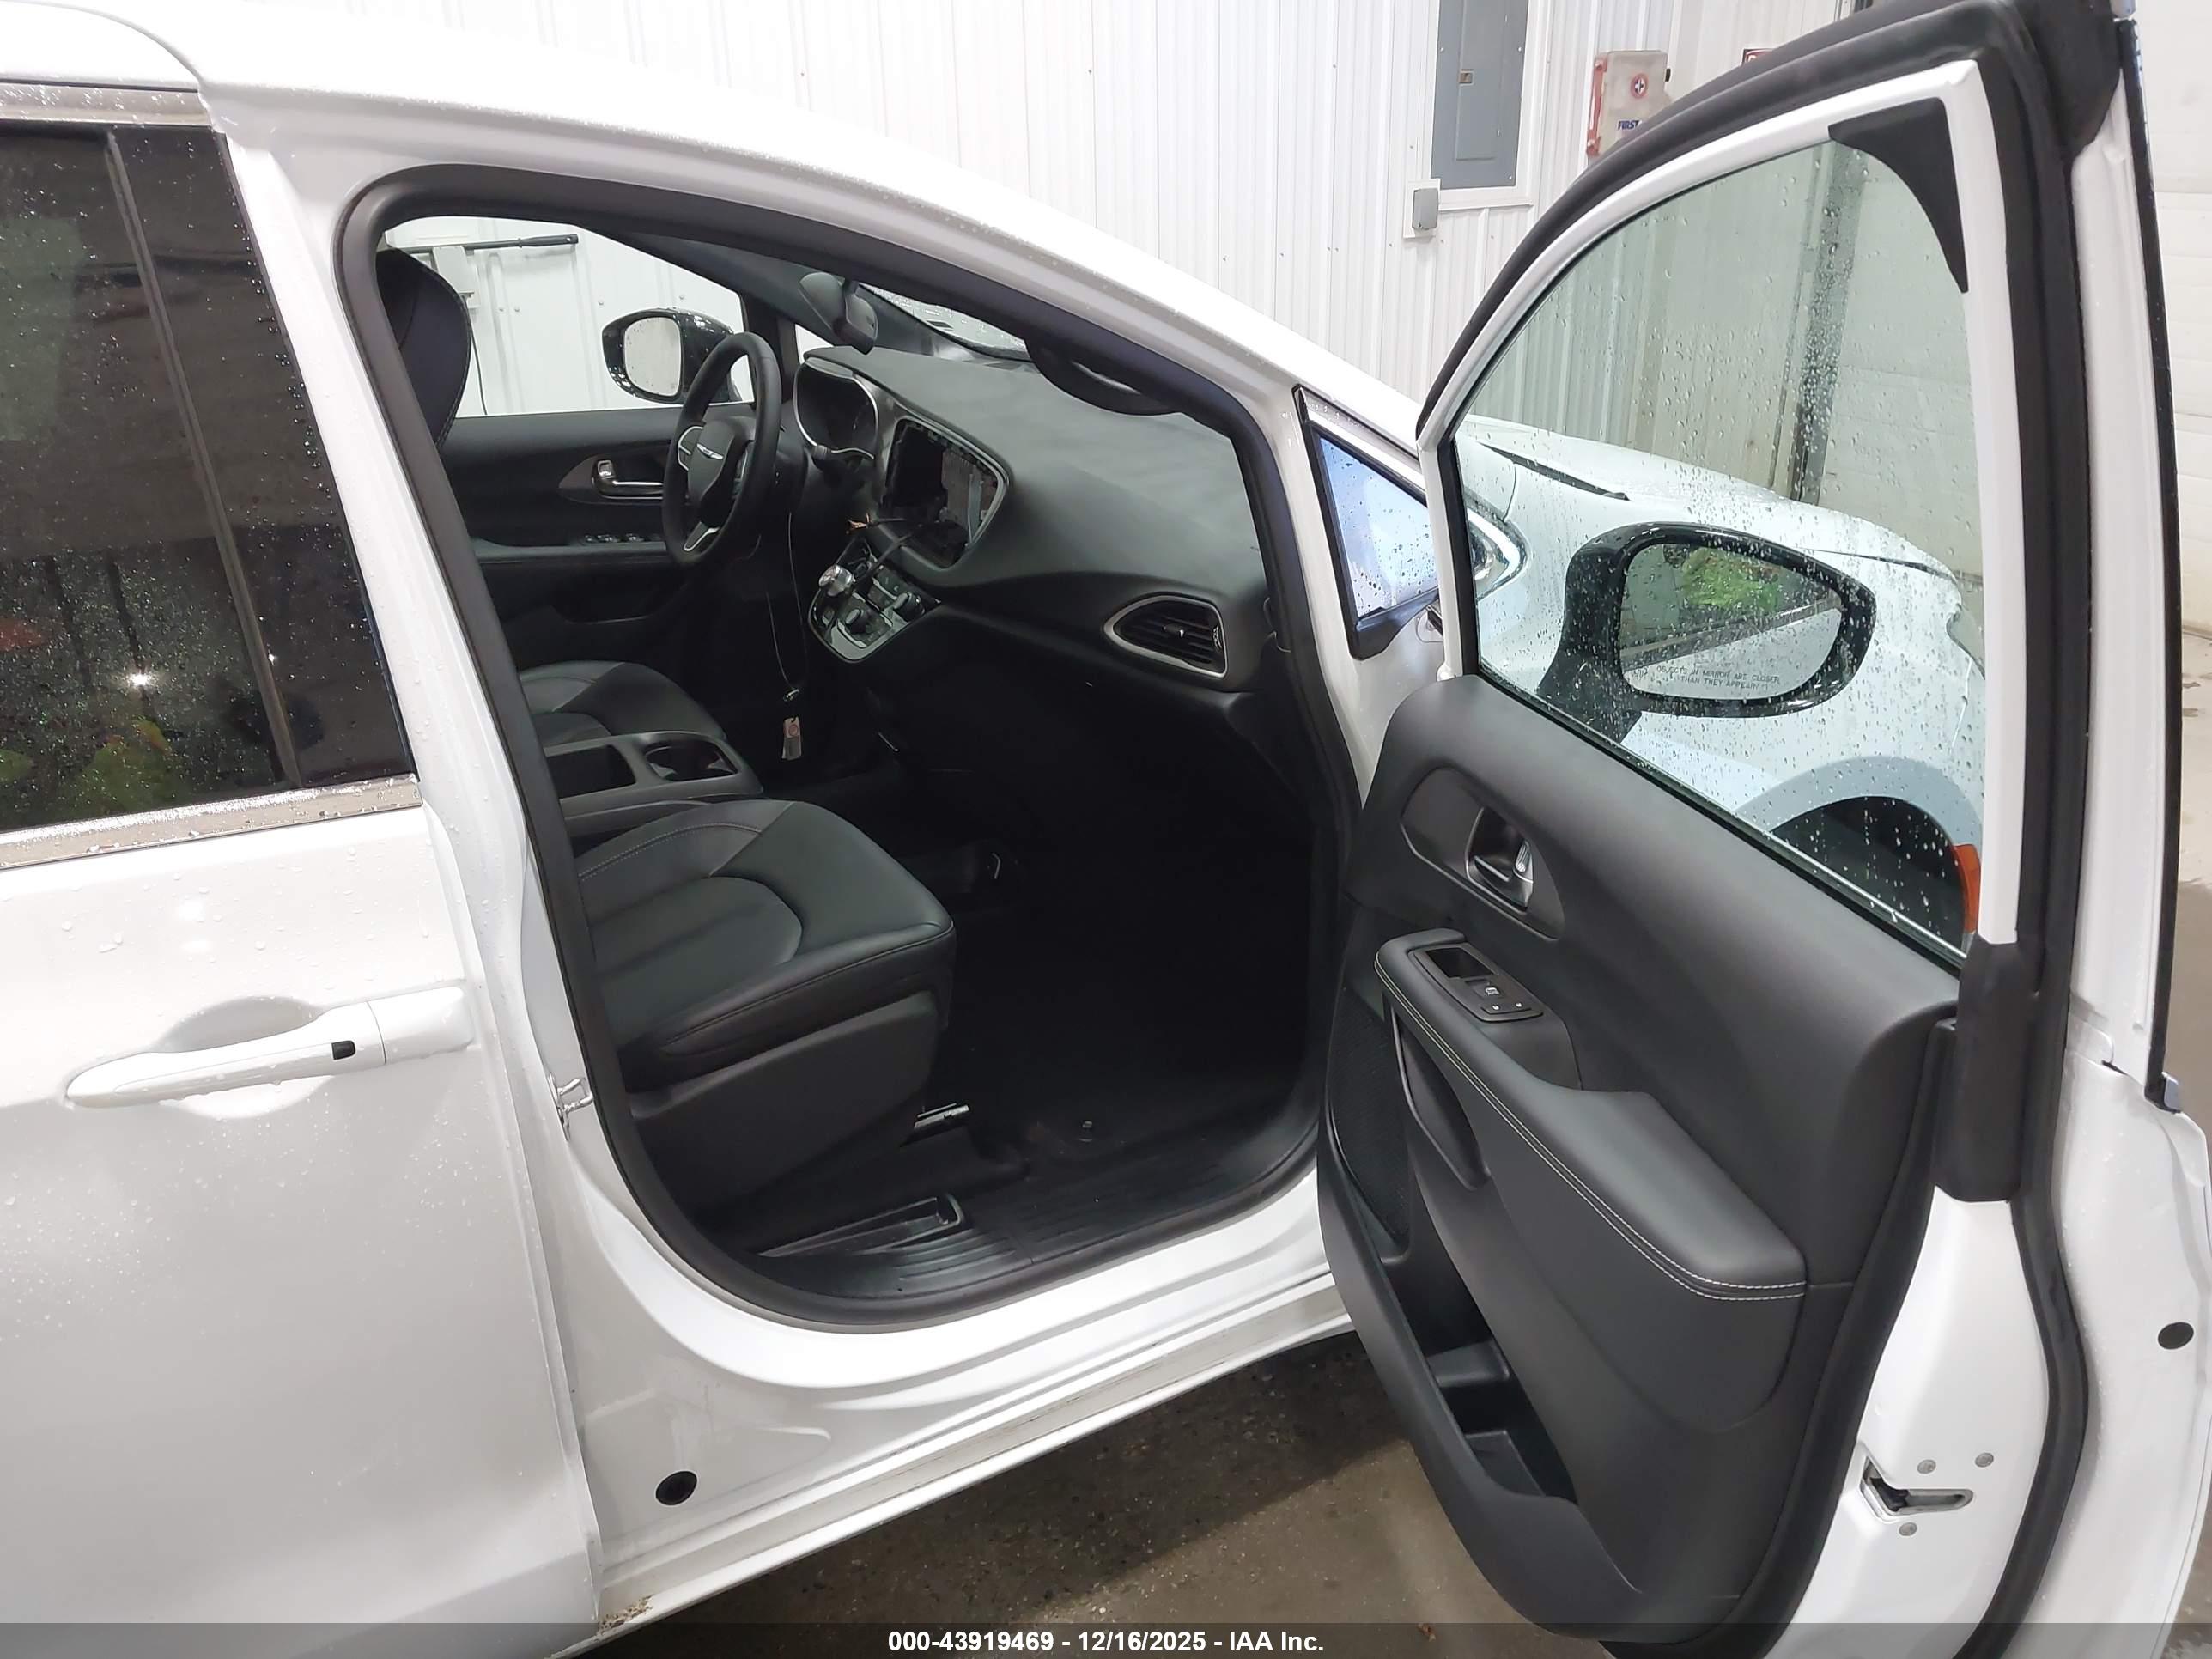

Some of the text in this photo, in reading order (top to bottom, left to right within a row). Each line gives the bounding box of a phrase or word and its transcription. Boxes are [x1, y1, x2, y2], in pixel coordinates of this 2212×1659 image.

[1656, 665, 1687, 674] OBJECTS
[1751, 674, 1780, 684] CLOSER
[1705, 678, 1723, 686] THEY
